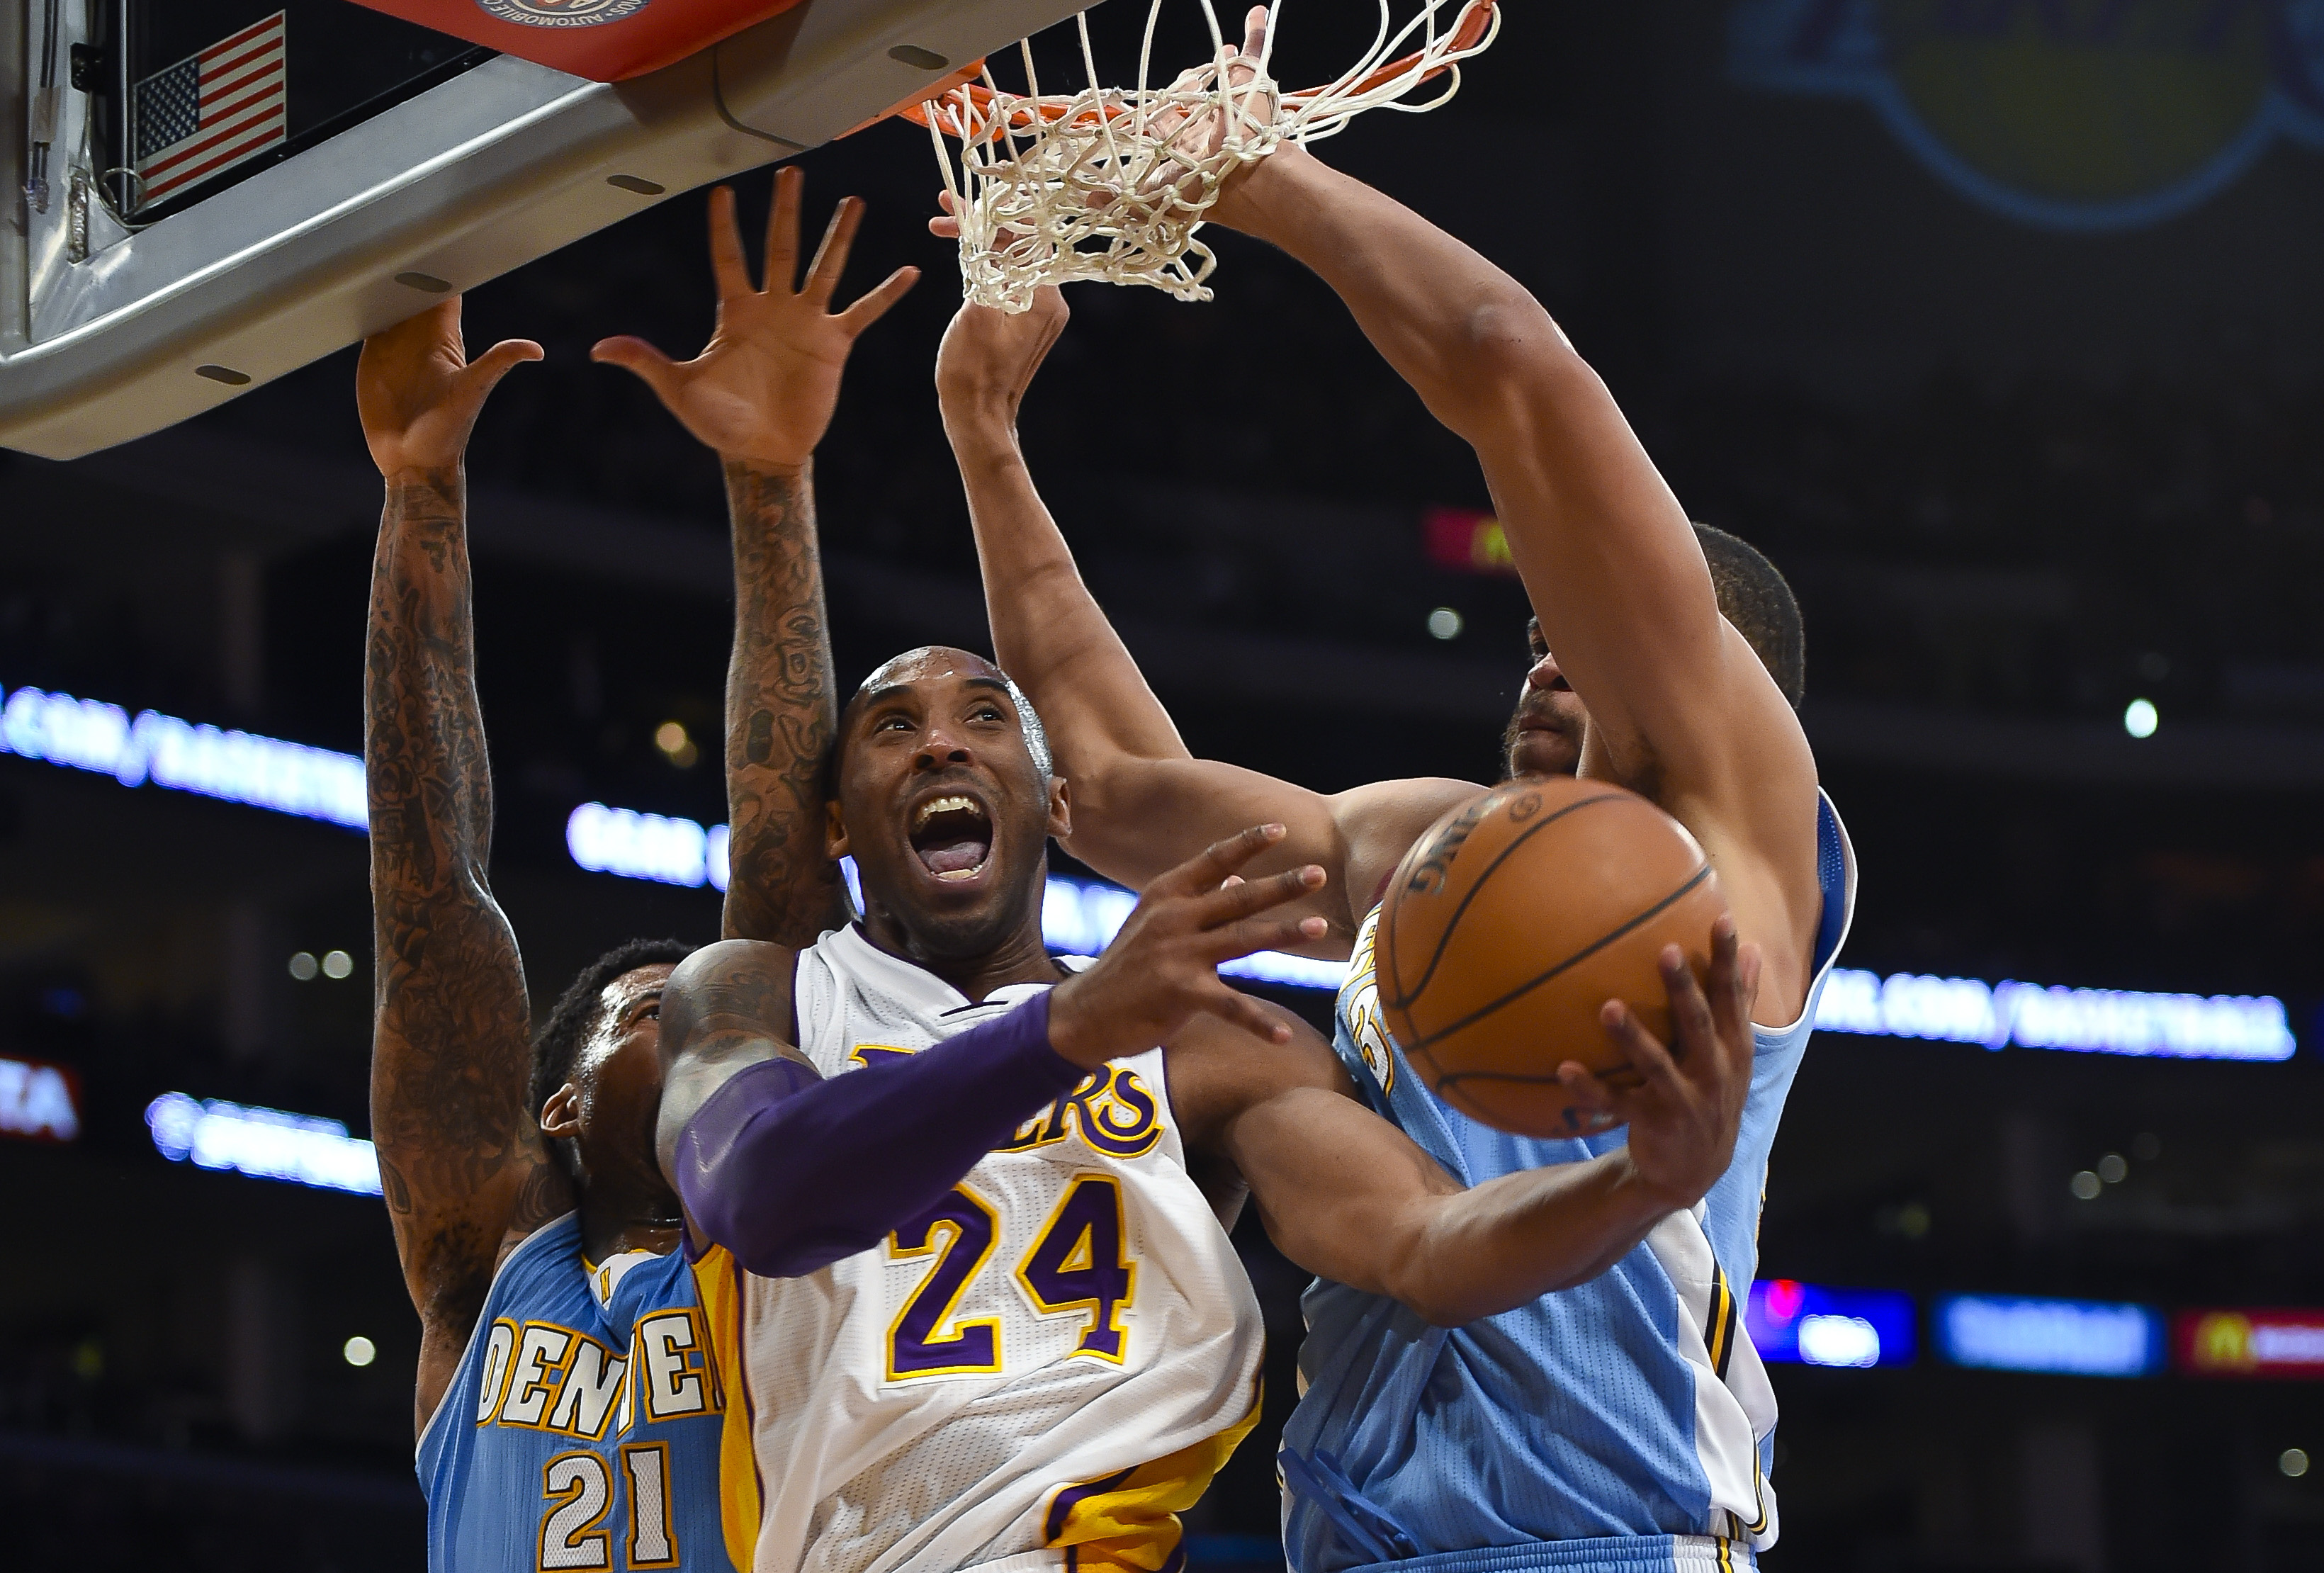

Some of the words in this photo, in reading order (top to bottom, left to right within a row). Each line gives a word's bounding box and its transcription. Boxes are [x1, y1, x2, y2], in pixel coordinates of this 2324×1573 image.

[489, 2, 604, 26] AUTOMOBILE
[885, 1173, 1138, 1382] 24
[476, 1307, 726, 1441] DENE
[536, 1440, 680, 1573] 21
